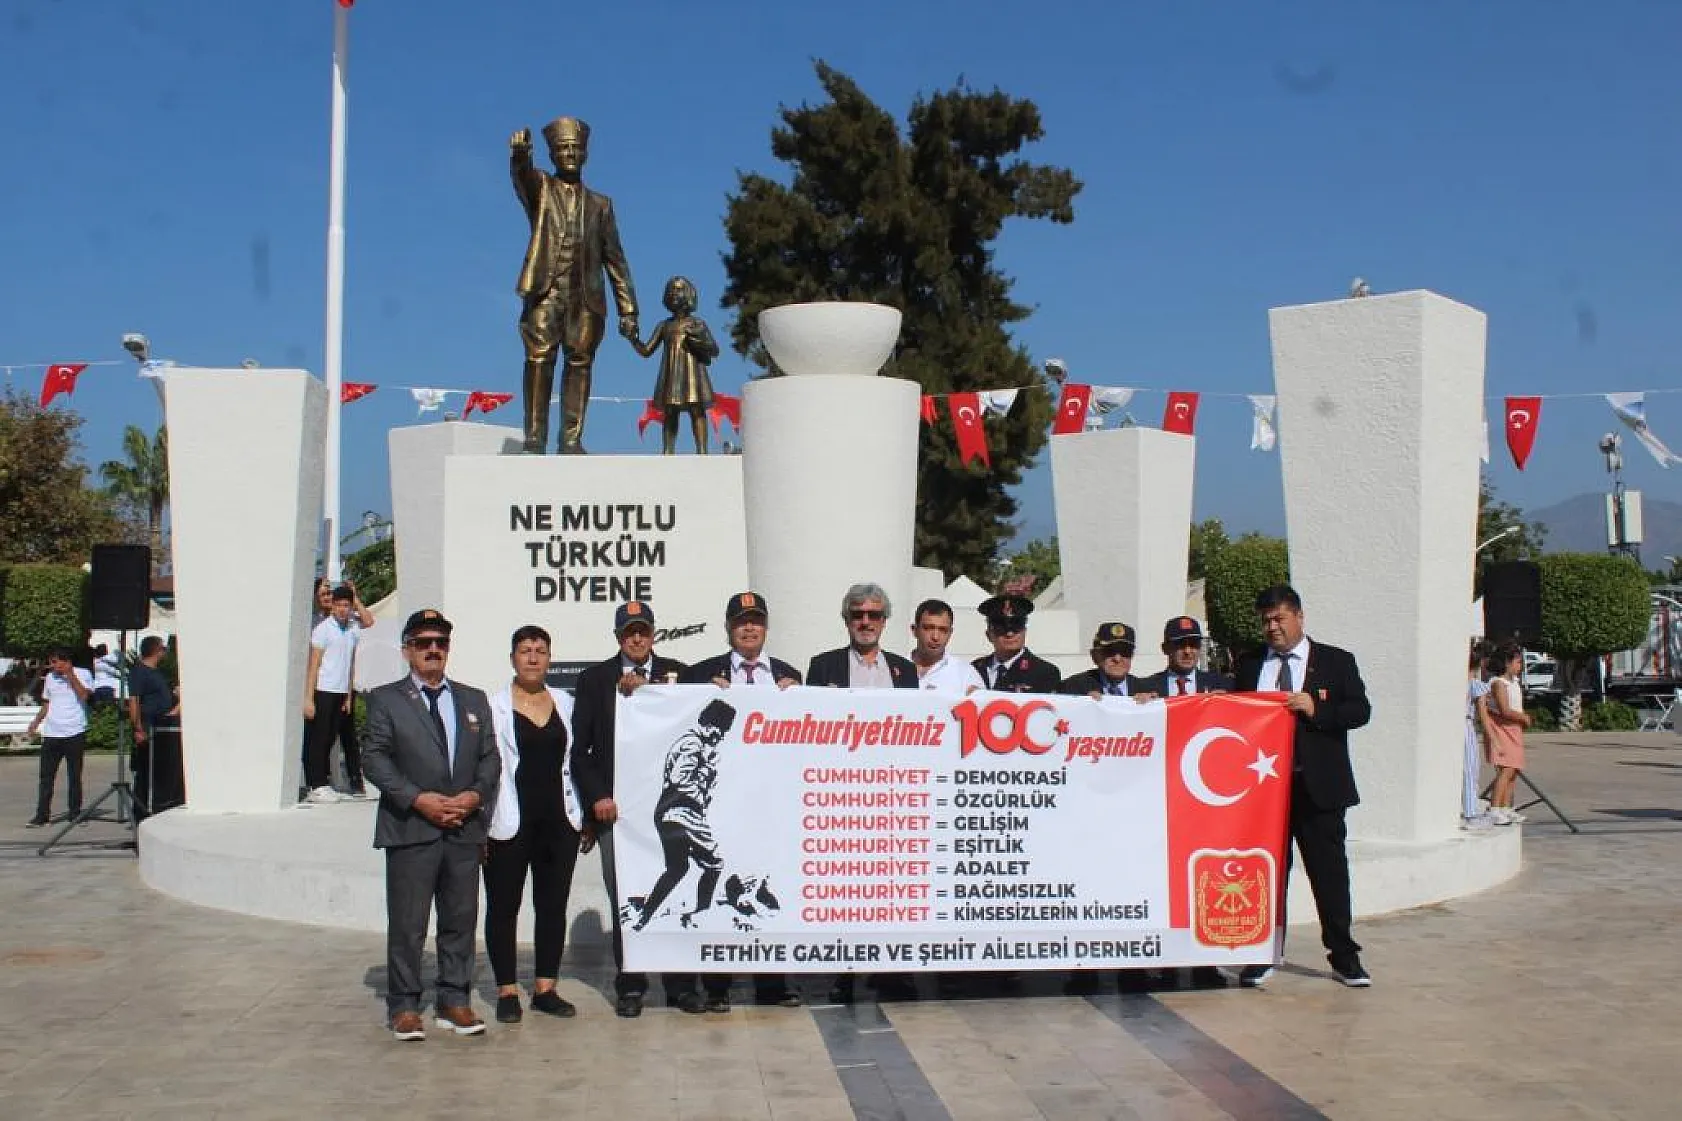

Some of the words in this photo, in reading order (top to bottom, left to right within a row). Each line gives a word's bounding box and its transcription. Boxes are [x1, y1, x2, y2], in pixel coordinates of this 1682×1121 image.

[510, 504, 552, 531] NE
[562, 504, 676, 532] MUTLU
[525, 534, 666, 568] TÜRKÜM
[535, 568, 653, 602] DİYENE
[742, 711, 946, 752] Cumhuriyetimiz
[951, 698, 1057, 758] 100
[1065, 731, 1154, 763] yaşında
[803, 765, 930, 784] CUMHURİYET
[954, 766, 1068, 785] DEMOKRASİ
[803, 788, 930, 808] CUMHURİYET
[954, 789, 1057, 808] ÖZGÜRLÜK
[803, 811, 930, 831] CUMHURİYET
[954, 811, 1029, 835] GELİŞİM
[803, 835, 930, 854] CUMHURİYET
[954, 835, 1024, 858] EŞİTLİK
[803, 857, 930, 876] CUMHURİYET
[954, 860, 1030, 876] ADALET
[803, 880, 930, 900] CUMHURİYET
[954, 880, 1076, 899] BAĞIMSIZLIK
[803, 902, 930, 922] CUMHURİYET
[954, 901, 1078, 921] KİMSESİZLERİN
[1083, 900, 1149, 921] KİMSESİ
[700, 939, 787, 962] FETHİYE
[793, 938, 880, 962] GAZİLER
[887, 944, 913, 961] VE
[918, 937, 977, 966] ŞEHİT
[982, 936, 1068, 961] AİLELERİ
[1075, 934, 1162, 958] DERNEĞİ
